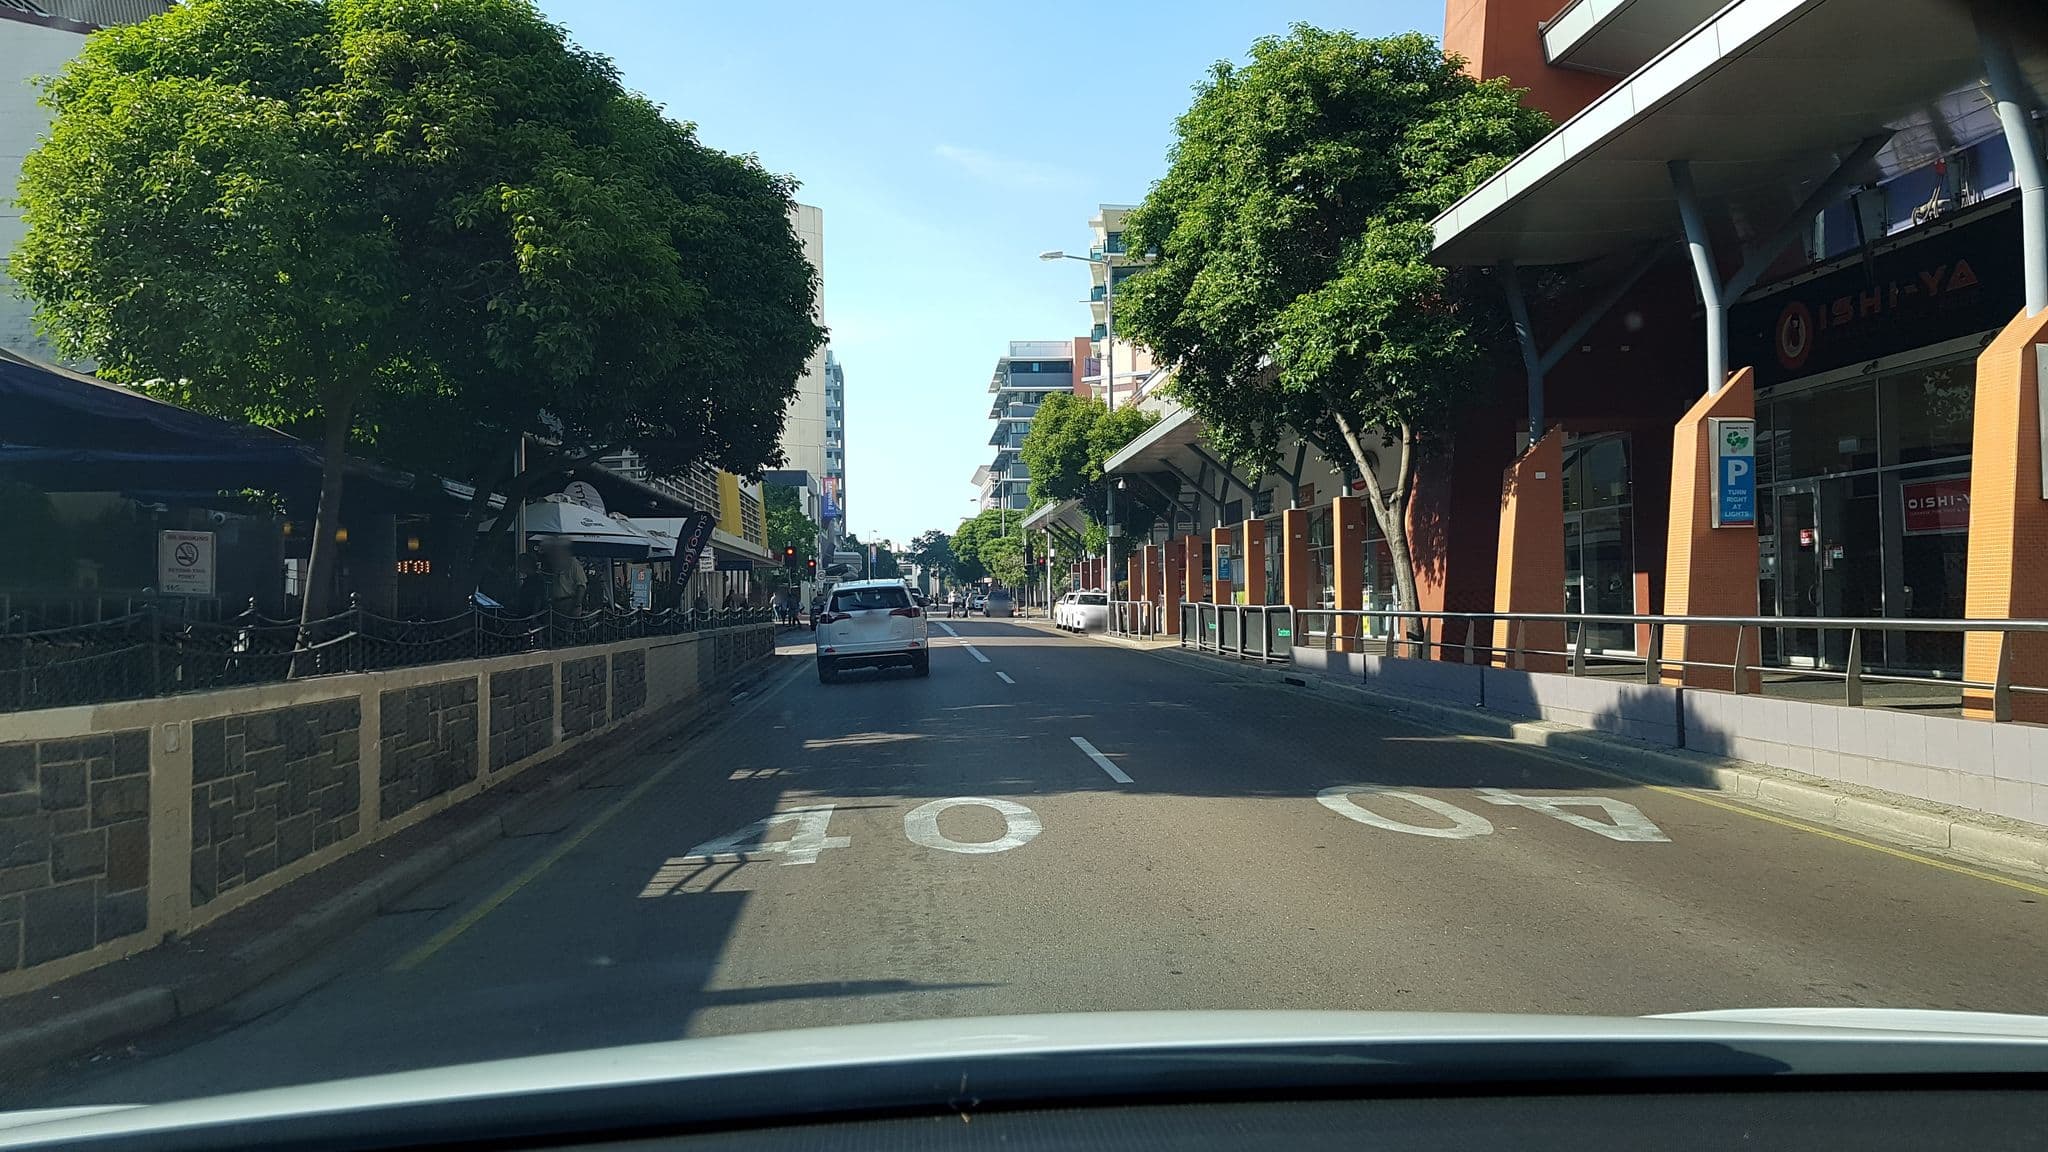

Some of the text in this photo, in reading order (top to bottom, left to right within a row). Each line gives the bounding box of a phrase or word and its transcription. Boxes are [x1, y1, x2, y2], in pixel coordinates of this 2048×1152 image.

[1776, 258, 1979, 370] OISHI-YA
[1727, 459, 1748, 486] P
[1221, 559, 1228, 568] P
